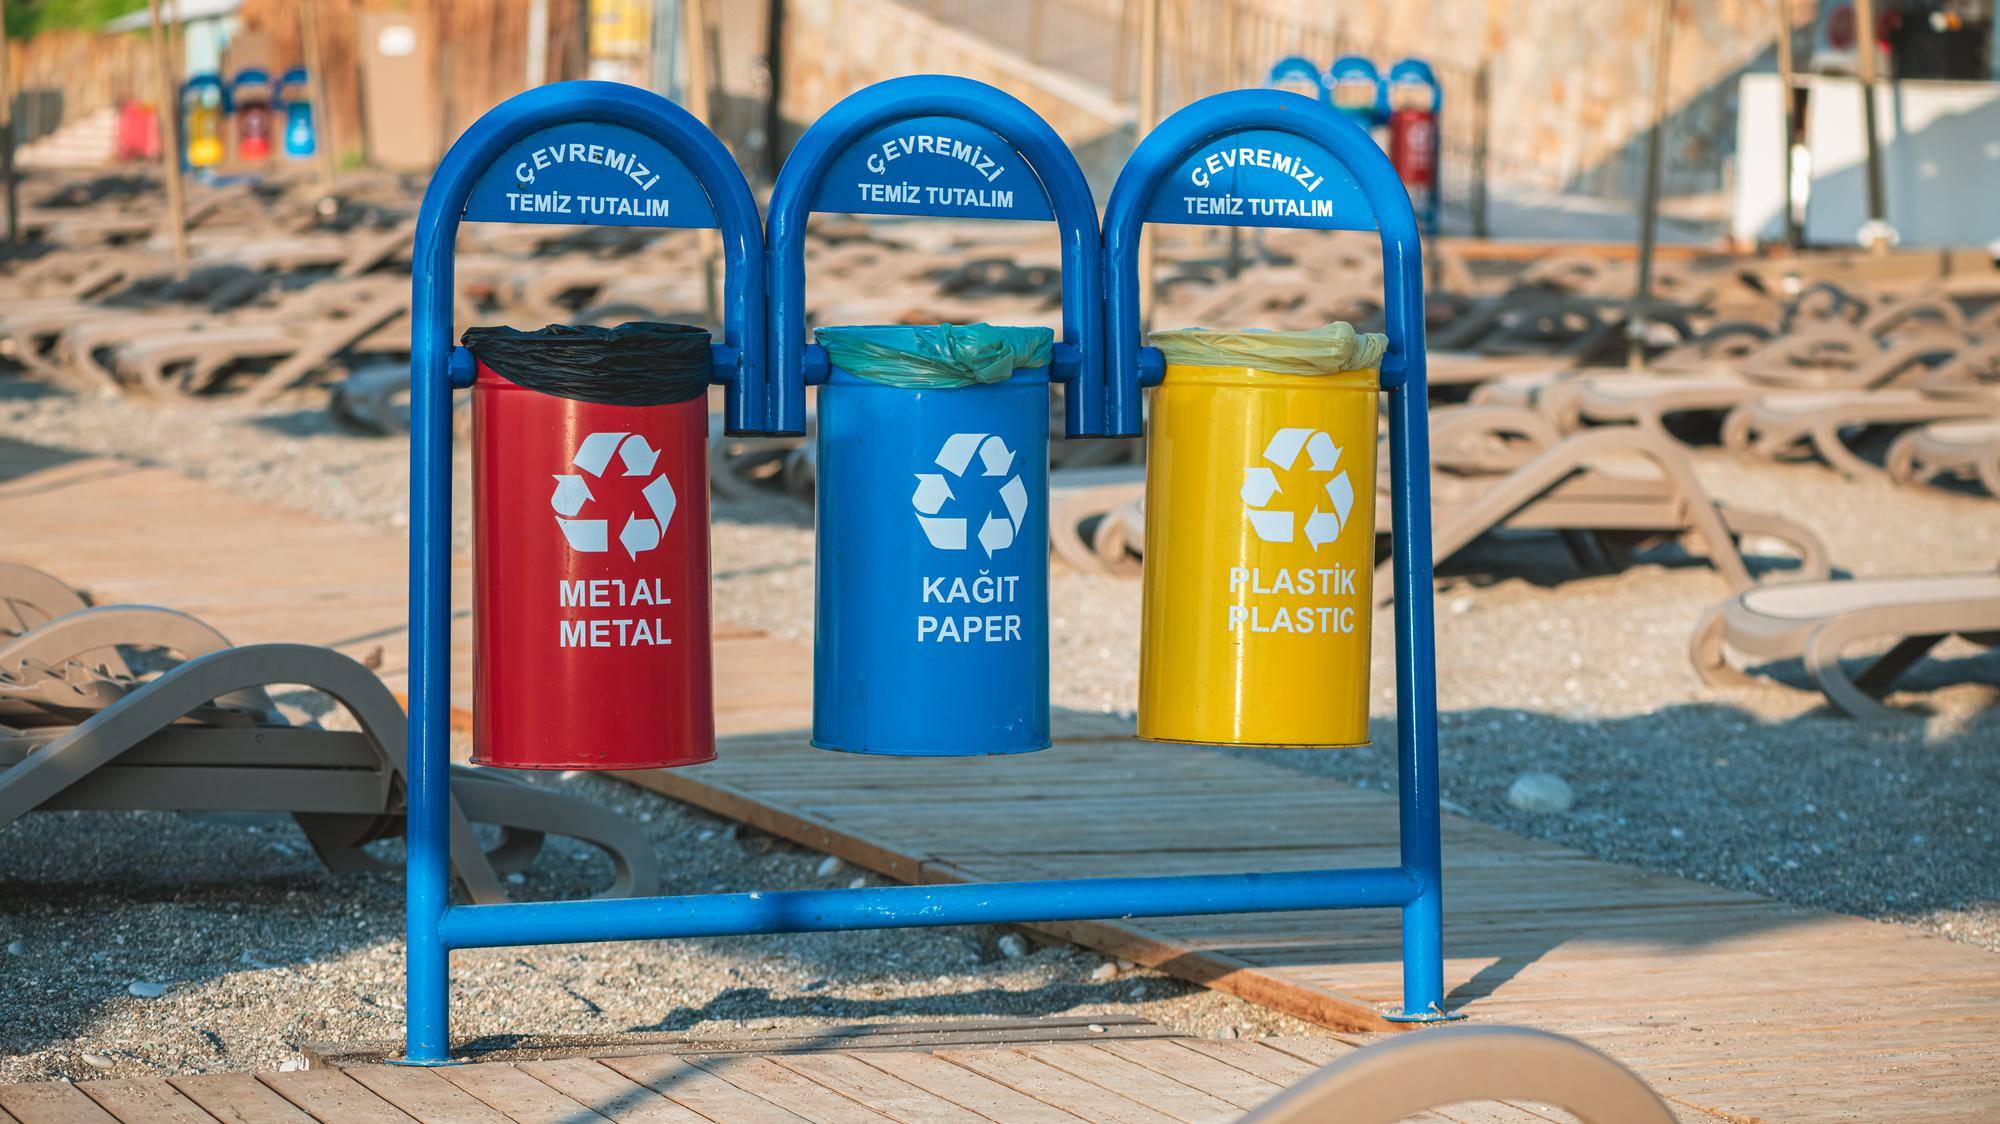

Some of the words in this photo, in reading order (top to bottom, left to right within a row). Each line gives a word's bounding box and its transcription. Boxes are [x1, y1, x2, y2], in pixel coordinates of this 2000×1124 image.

[515, 143, 661, 191] ÇEVREMİZİ
[866, 135, 1005, 183] ÇEVREMİZİ
[1191, 147, 1325, 193] ÇEVREMİZİ
[506, 190, 572, 213] TEMİZ
[576, 195, 669, 217] TUTALIM
[857, 181, 921, 204] TEMİZ
[925, 187, 1013, 208] TUTALIM
[1183, 193, 1244, 216] TEMİZ
[1247, 198, 1333, 217] TUTALIM
[922, 568, 1020, 604] KAĞIT
[1229, 562, 1356, 595] PLASTİK
[559, 618, 672, 648] METAL
[916, 614, 1022, 643] PAPER
[1227, 605, 1355, 634] PLASTIC
